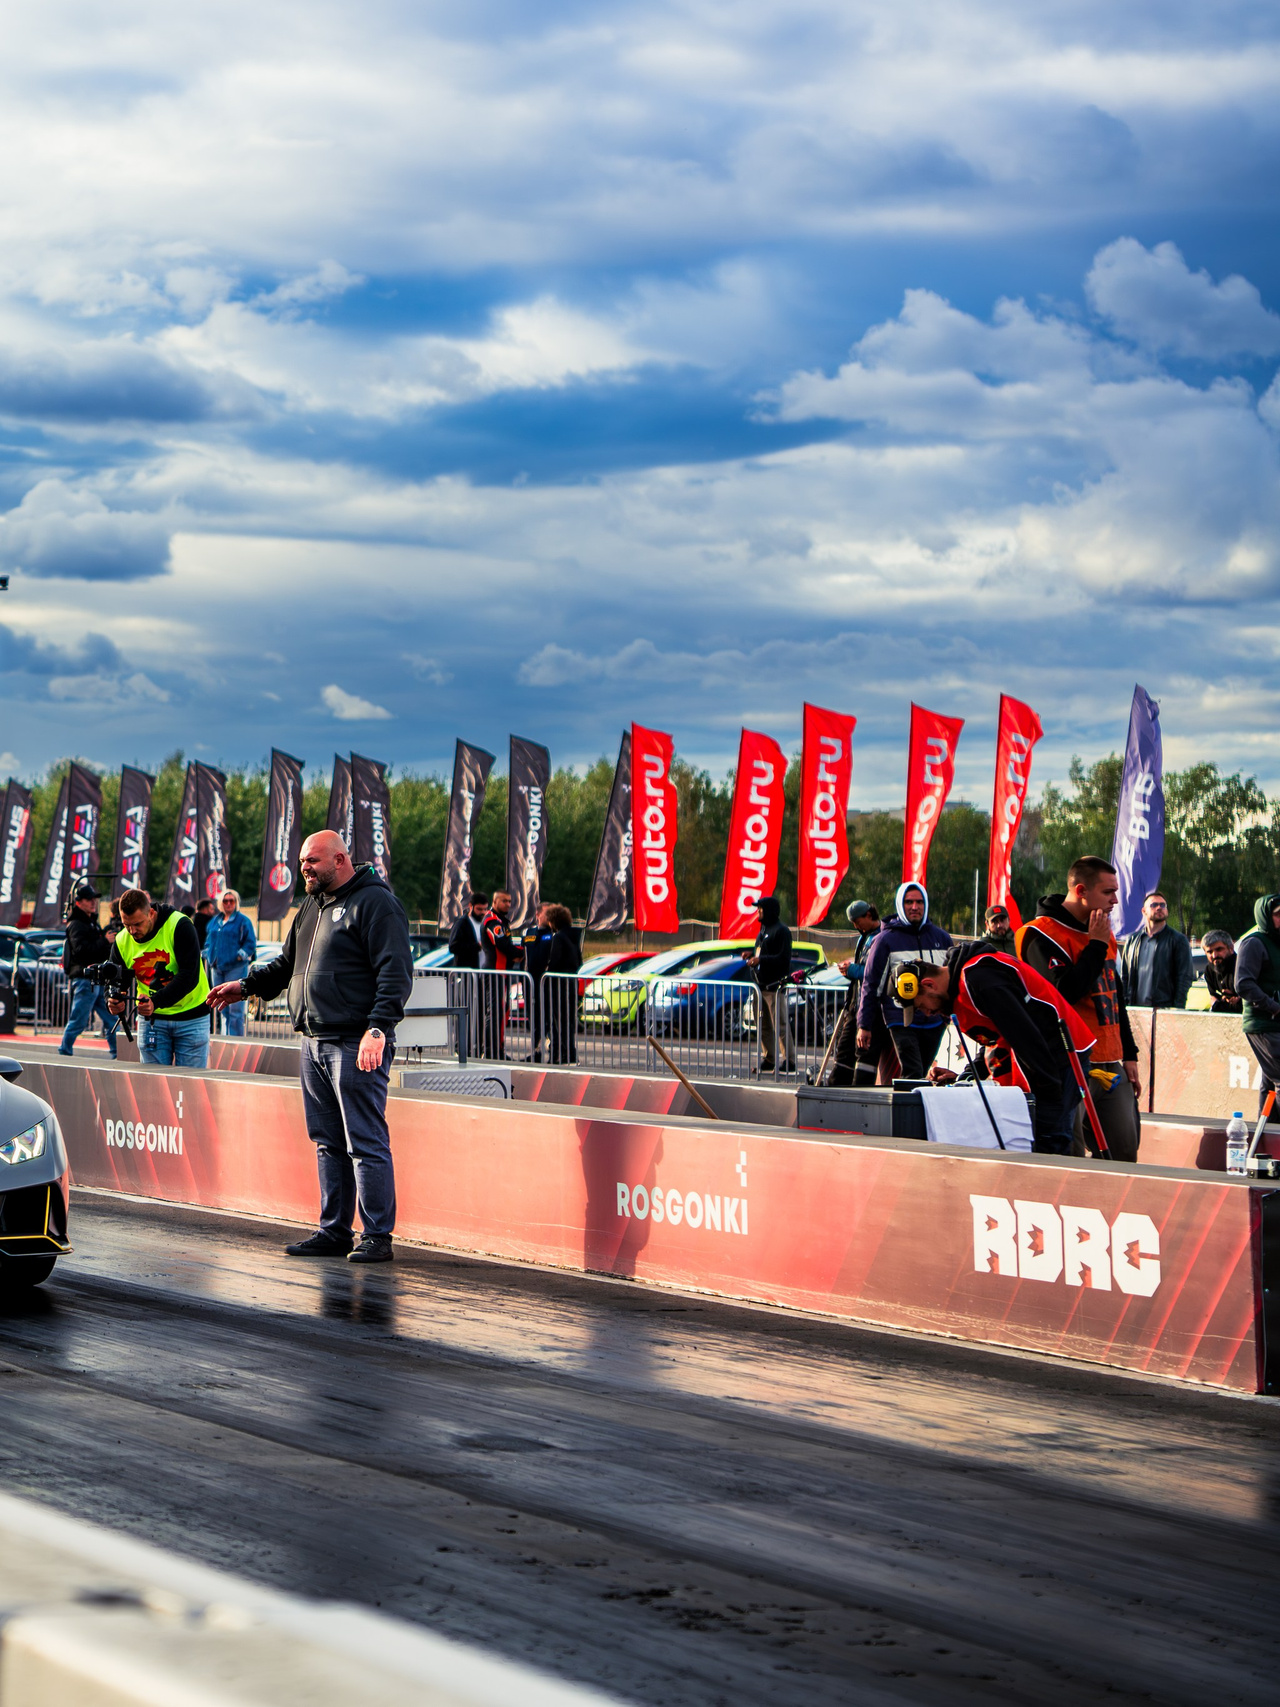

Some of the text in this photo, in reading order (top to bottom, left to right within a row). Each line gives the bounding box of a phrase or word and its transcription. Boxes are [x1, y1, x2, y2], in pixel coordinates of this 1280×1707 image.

[175, 808, 198, 893] LEVE
[371, 801, 387, 880] OSGONKI
[642, 753, 669, 904] auto.ru
[736, 760, 775, 915] auto.ru
[809, 735, 843, 898] auto.ru
[1128, 771, 1157, 840] ВТБ
[0, 804, 24, 904] VAGPLUS
[106, 1119, 183, 1155] ROSGONKI
[616, 1182, 749, 1236] ROSGONKI
[969, 1193, 1162, 1298] RDRC
